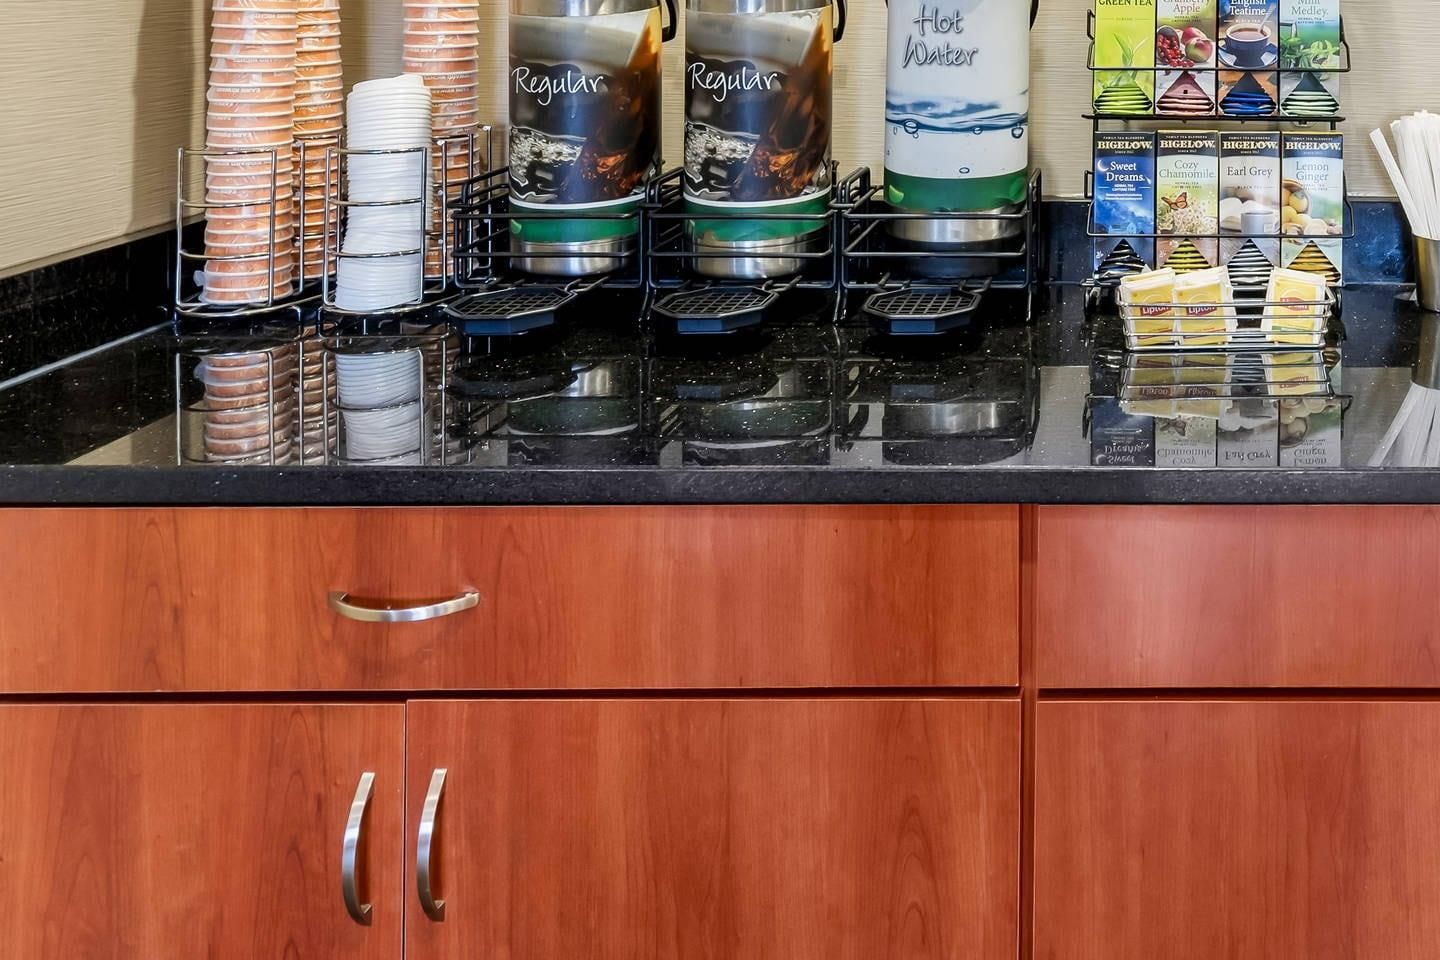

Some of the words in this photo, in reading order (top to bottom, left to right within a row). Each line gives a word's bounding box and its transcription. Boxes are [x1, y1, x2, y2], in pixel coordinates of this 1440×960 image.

[1173, 4, 1200, 15] Apple
[1229, 6, 1266, 16] Teatime
[1291, 6, 1327, 17] Medley
[912, 3, 964, 36] Hot
[903, 33, 979, 69] Water
[511, 66, 604, 106] Regular
[688, 62, 779, 102] Regular
[1097, 141, 1152, 150] BIGELOW
[1160, 140, 1215, 149] BIGELOW
[1222, 141, 1278, 150] BIGELOW
[1285, 142, 1341, 151] BIGELOW
[1110, 161, 1137, 171] Sweet
[1174, 160, 1199, 171] Cozy
[1296, 161, 1329, 171] Lemon
[1106, 172, 1144, 182] Dreams
[1159, 169, 1215, 179] Chamomile
[1227, 166, 1247, 176] Earl
[1249, 166, 1273, 179] Grey
[1296, 170, 1329, 184] Ginger
